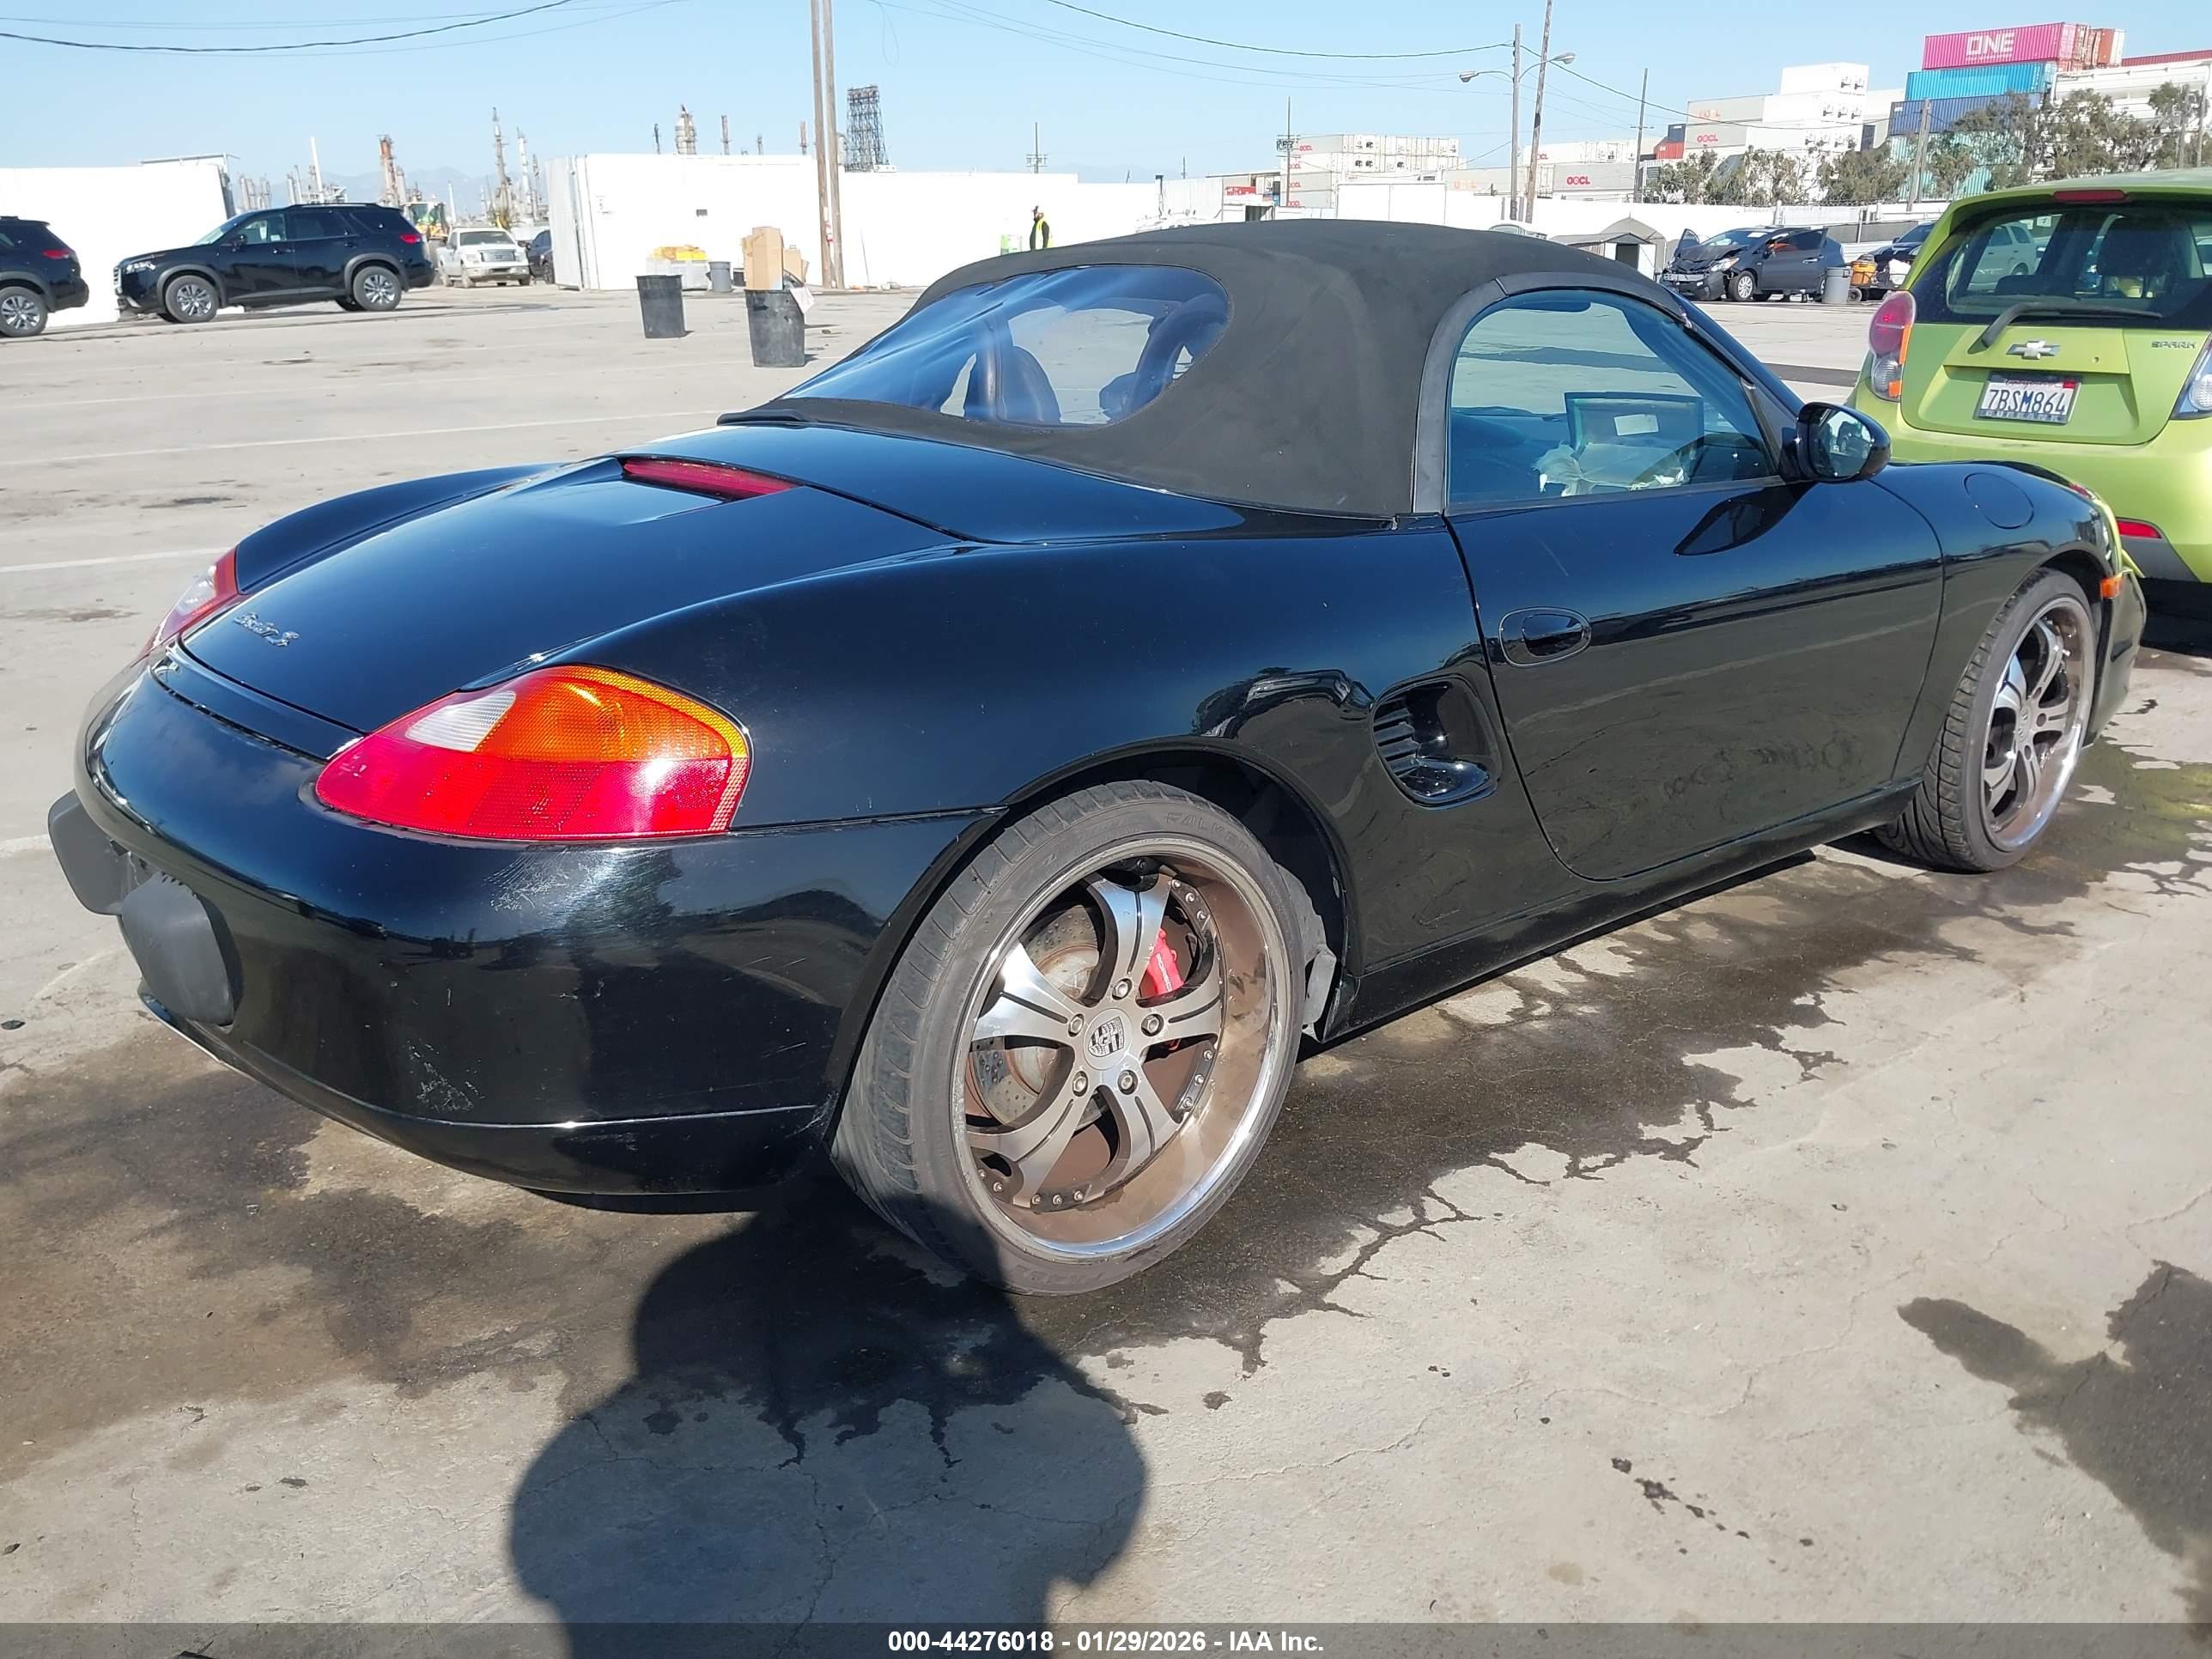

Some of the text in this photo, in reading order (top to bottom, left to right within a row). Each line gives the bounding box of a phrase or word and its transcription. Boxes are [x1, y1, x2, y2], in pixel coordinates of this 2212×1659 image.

[1966, 33, 2014, 56] ONE
[1697, 133, 1718, 143] OOCL
[1566, 175, 1590, 185] OOCL
[1988, 389, 2066, 413] 7BSM864
[1155, 953, 1173, 991] PORSC
